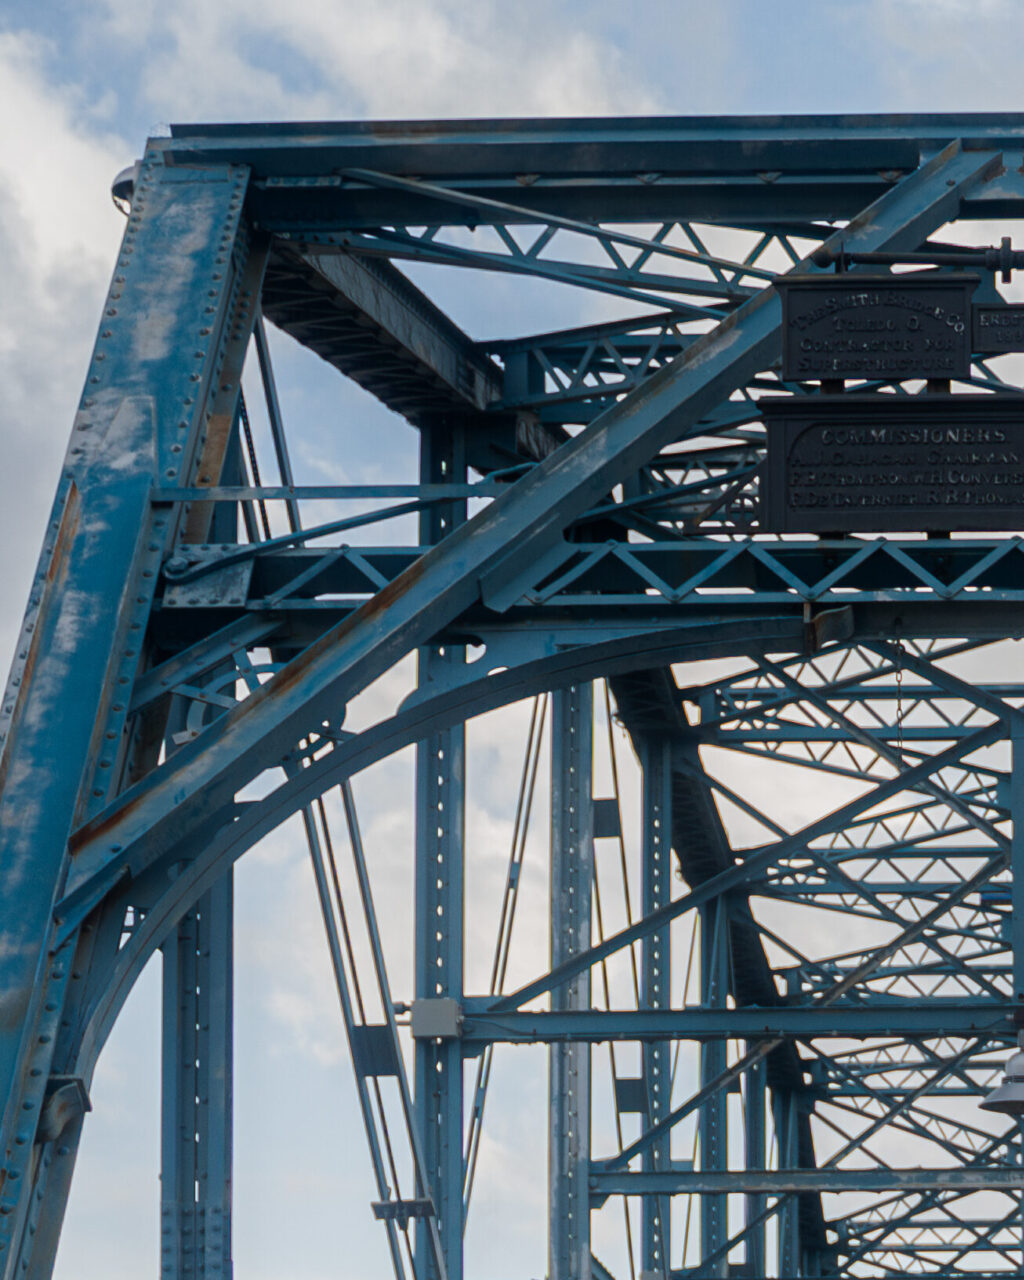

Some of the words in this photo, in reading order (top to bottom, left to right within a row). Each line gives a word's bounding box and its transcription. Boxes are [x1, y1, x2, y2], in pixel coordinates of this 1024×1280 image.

[824, 292, 880, 314] SMITH
[800, 338, 913, 352] CONTRACTOR
[924, 338, 955, 352] FOR
[798, 357, 954, 371] SUPERSTRUCTURE
